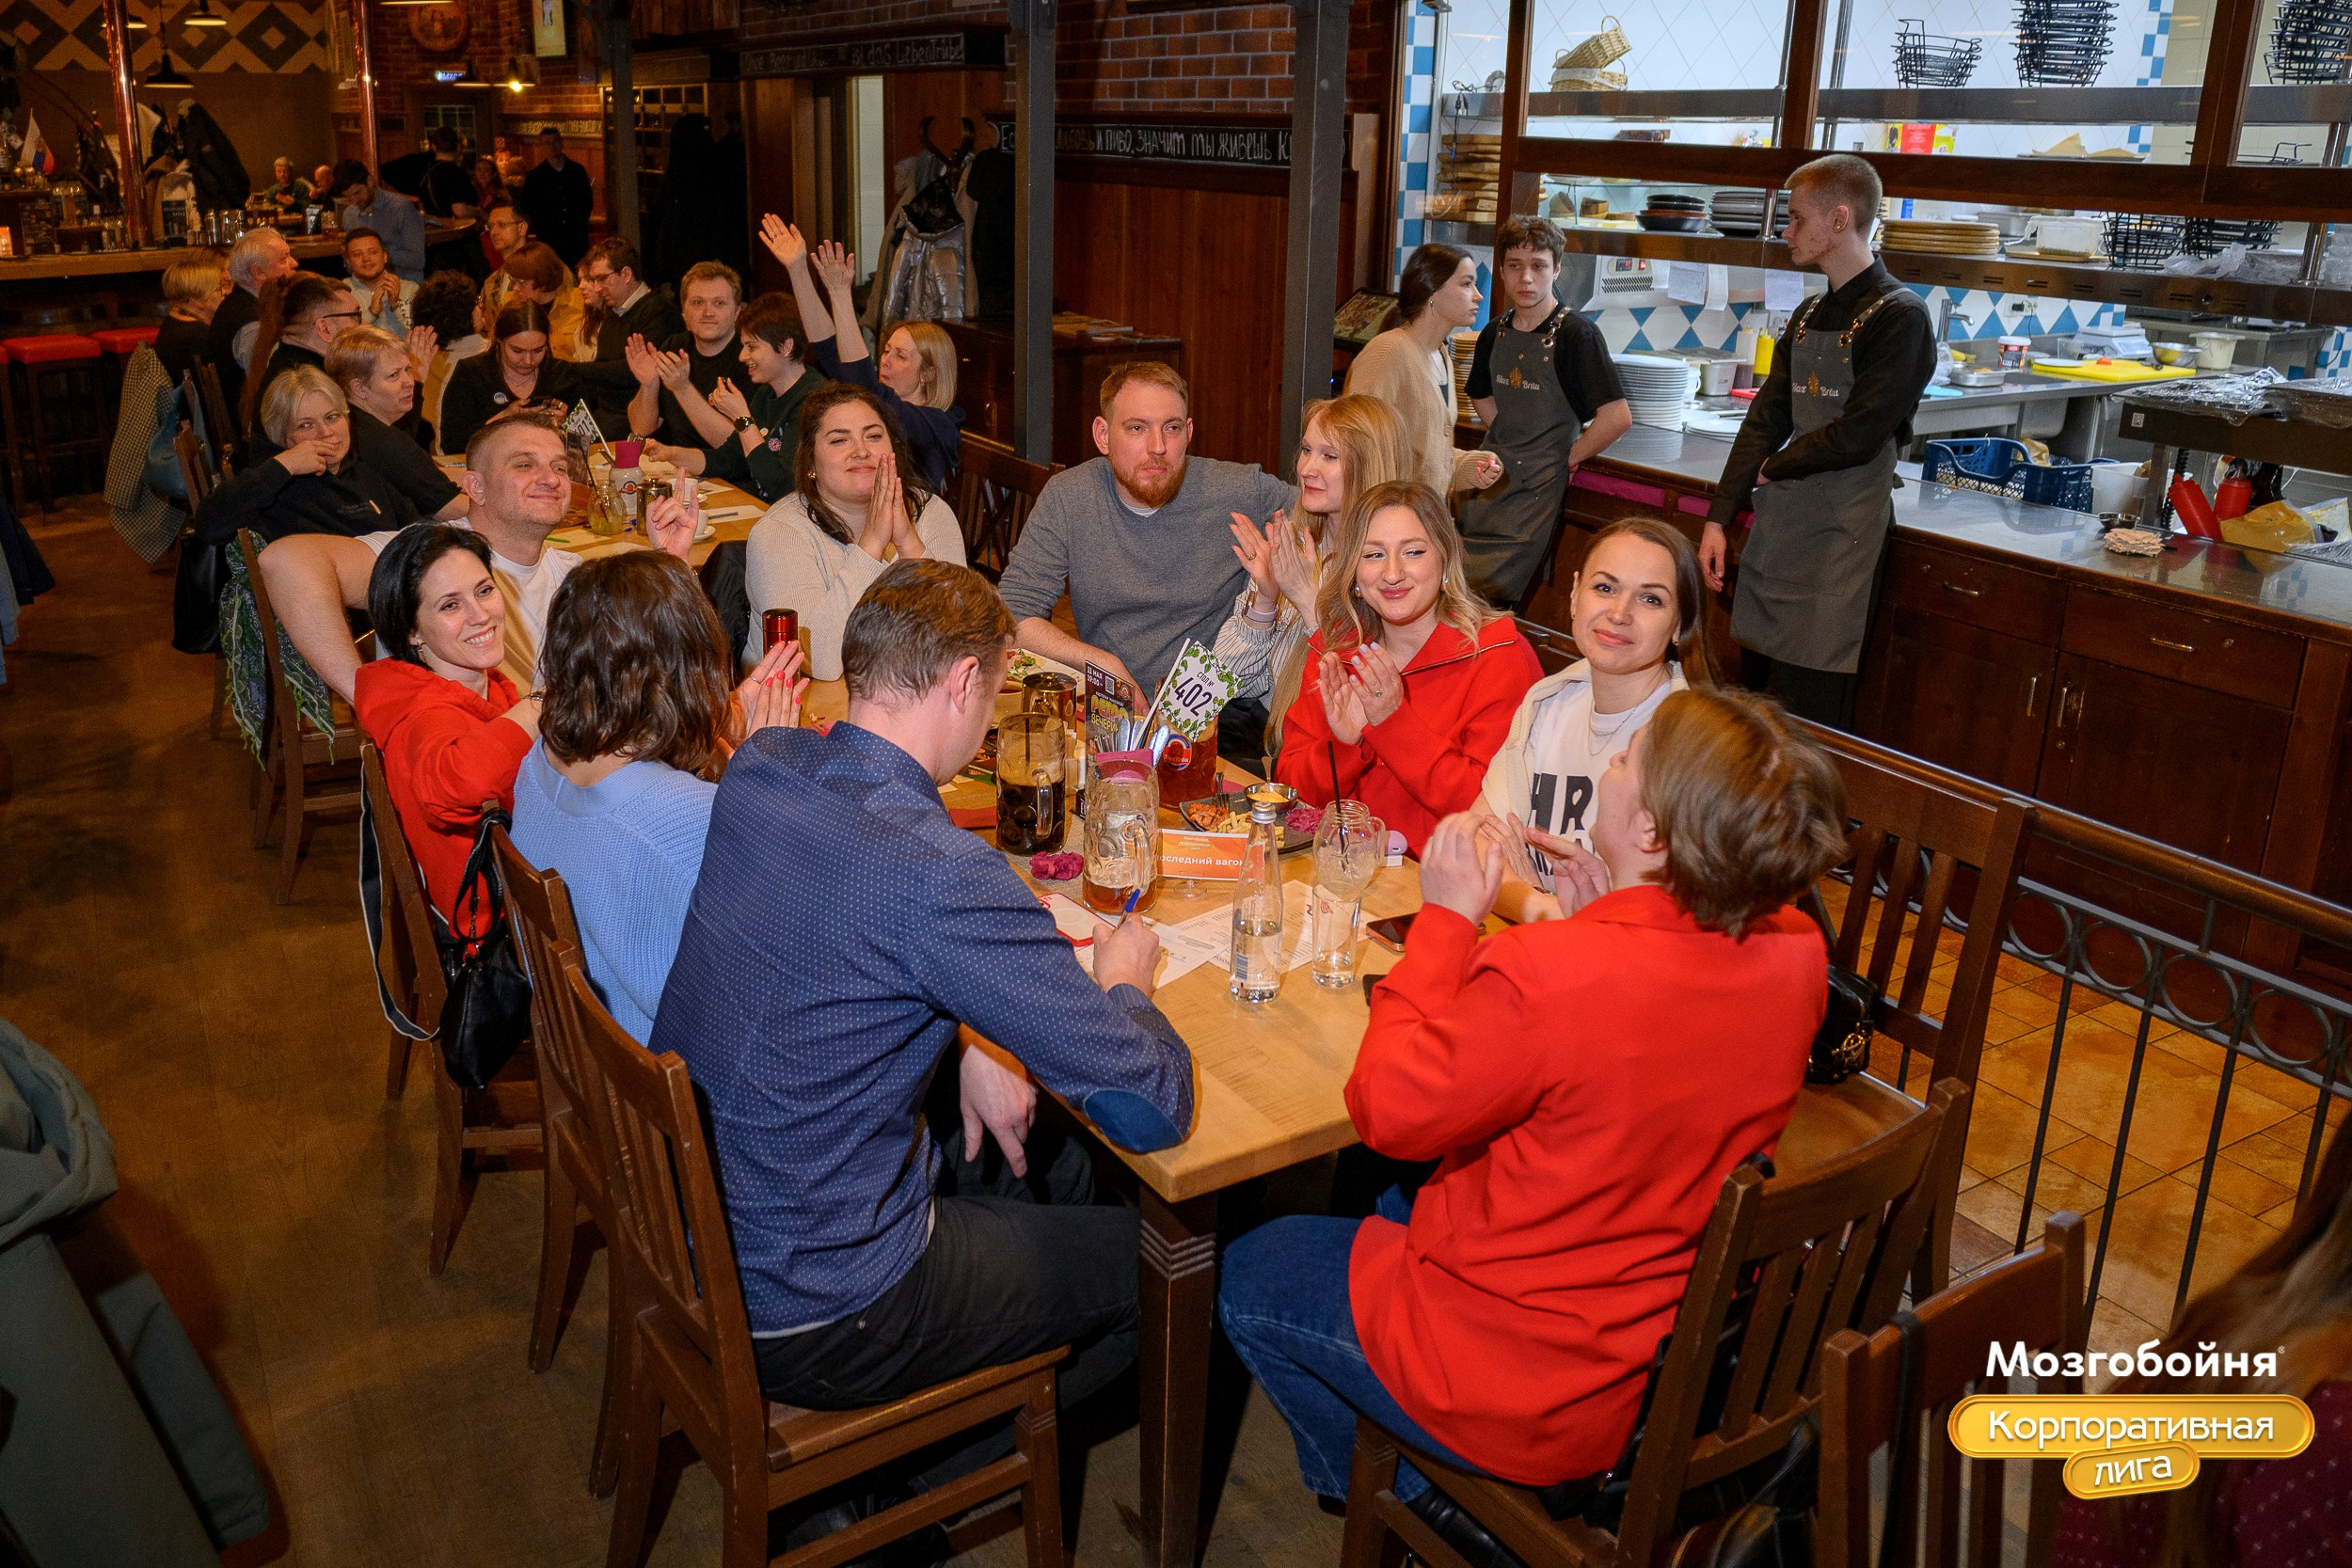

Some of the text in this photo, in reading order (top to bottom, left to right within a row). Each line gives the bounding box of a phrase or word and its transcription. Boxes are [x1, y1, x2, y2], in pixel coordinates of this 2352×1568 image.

[1197, 671, 1208, 685] СТОЛ
[1174, 677, 1213, 717] 402
[1156, 854, 1212, 865] оследний
